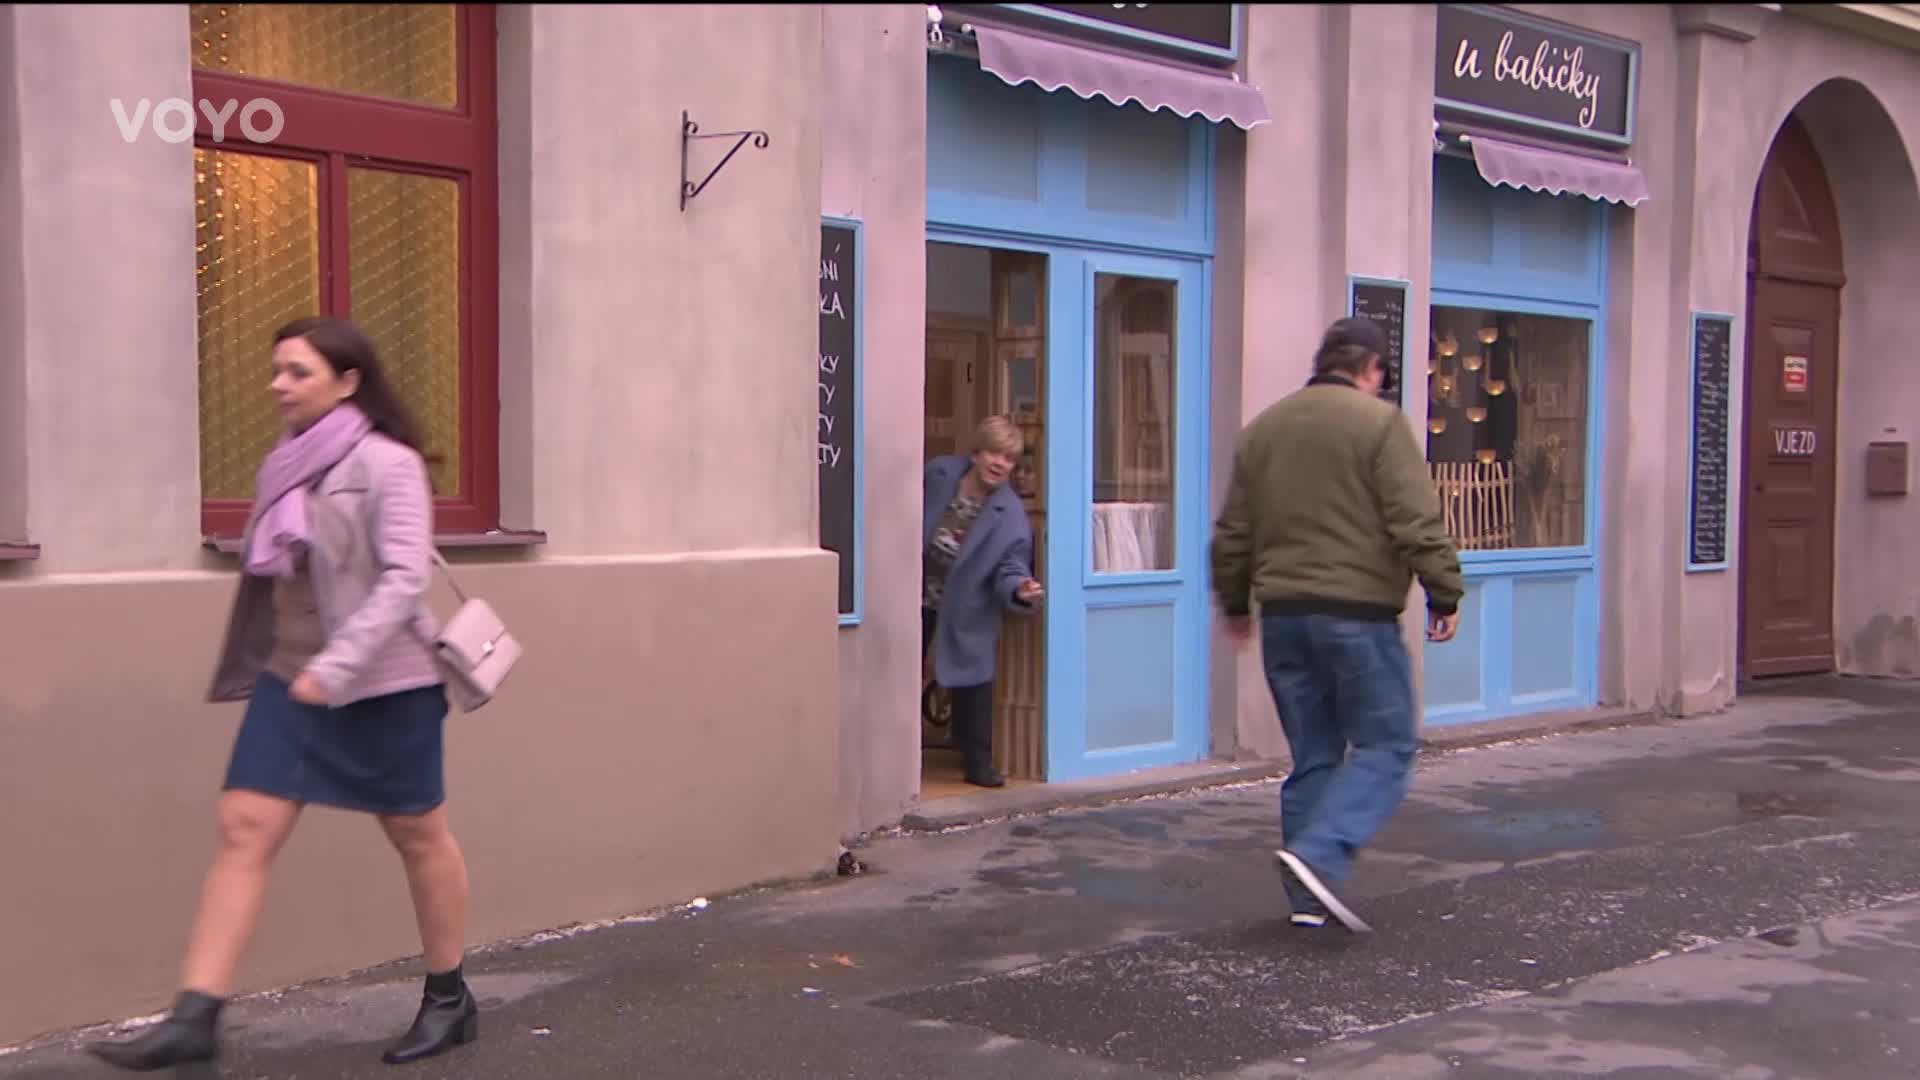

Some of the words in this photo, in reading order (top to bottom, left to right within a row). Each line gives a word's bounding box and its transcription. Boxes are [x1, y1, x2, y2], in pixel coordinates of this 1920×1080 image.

[1494, 30, 1600, 128] babičky
[819, 243, 840, 281] NÍ
[1775, 429, 1816, 454] VJEZD
